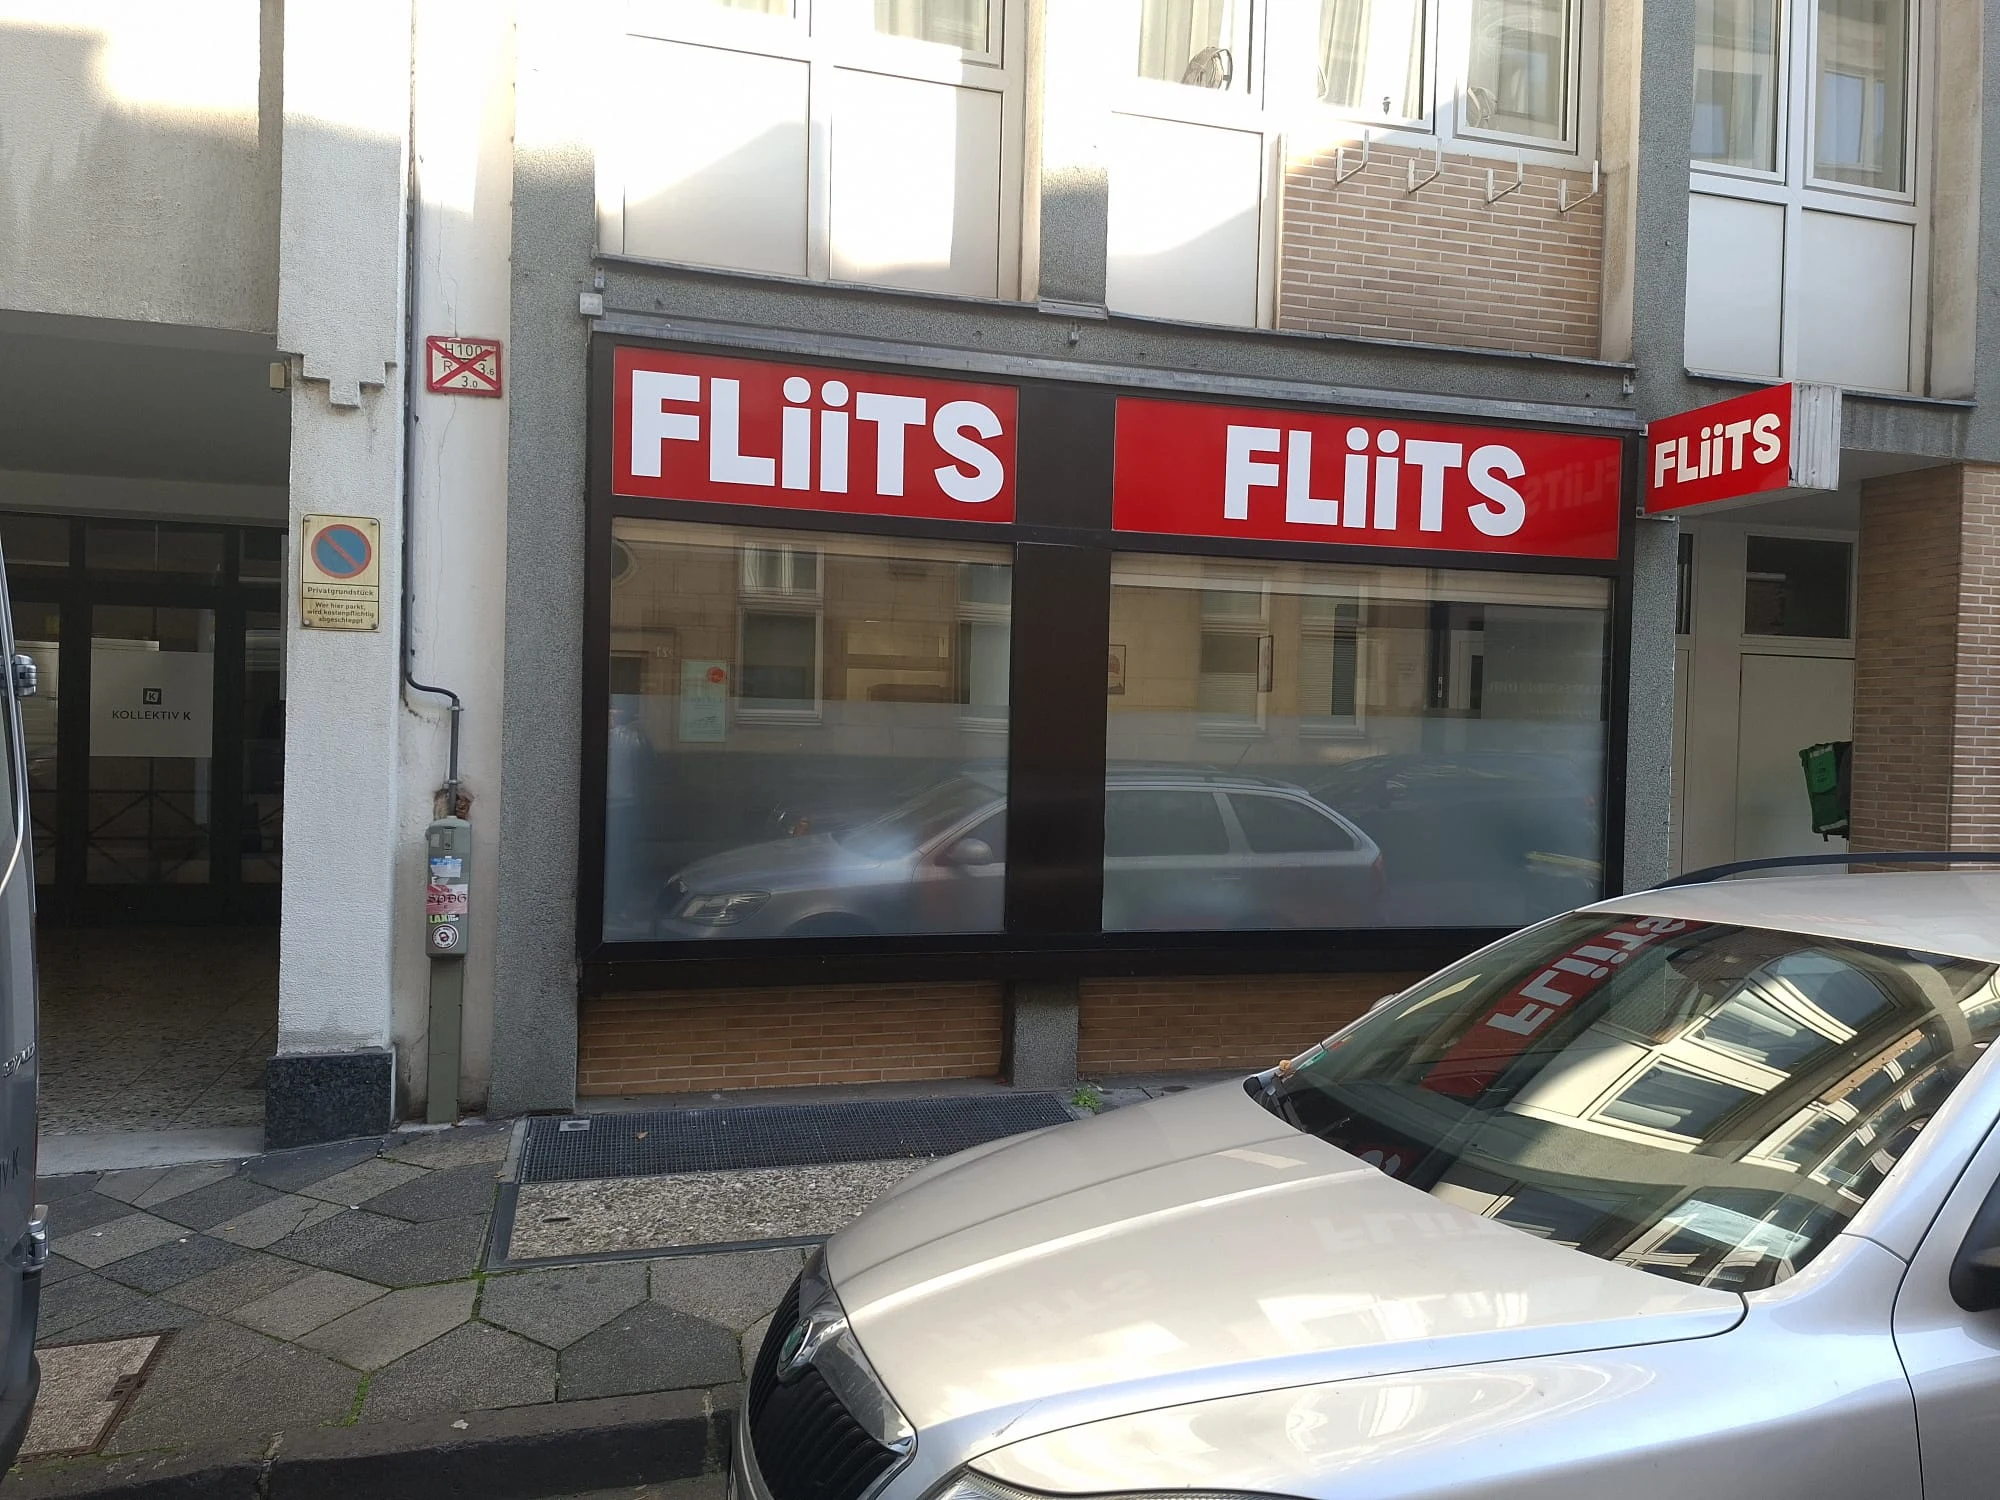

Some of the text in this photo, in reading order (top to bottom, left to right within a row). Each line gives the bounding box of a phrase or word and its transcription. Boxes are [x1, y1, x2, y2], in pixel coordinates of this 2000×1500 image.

[445, 343, 483, 357] H100
[443, 360, 453, 372] R
[461, 375, 478, 388] 3.0
[630, 368, 1005, 504] FLiiTS
[1654, 412, 1781, 489] FLiiTS
[1224, 424, 1526, 537] FLiiTS
[307, 586, 374, 597] Privatgrundstück
[323, 609, 375, 618] kostenpflichtig
[112, 710, 192, 721] KOLLEKTIV K
